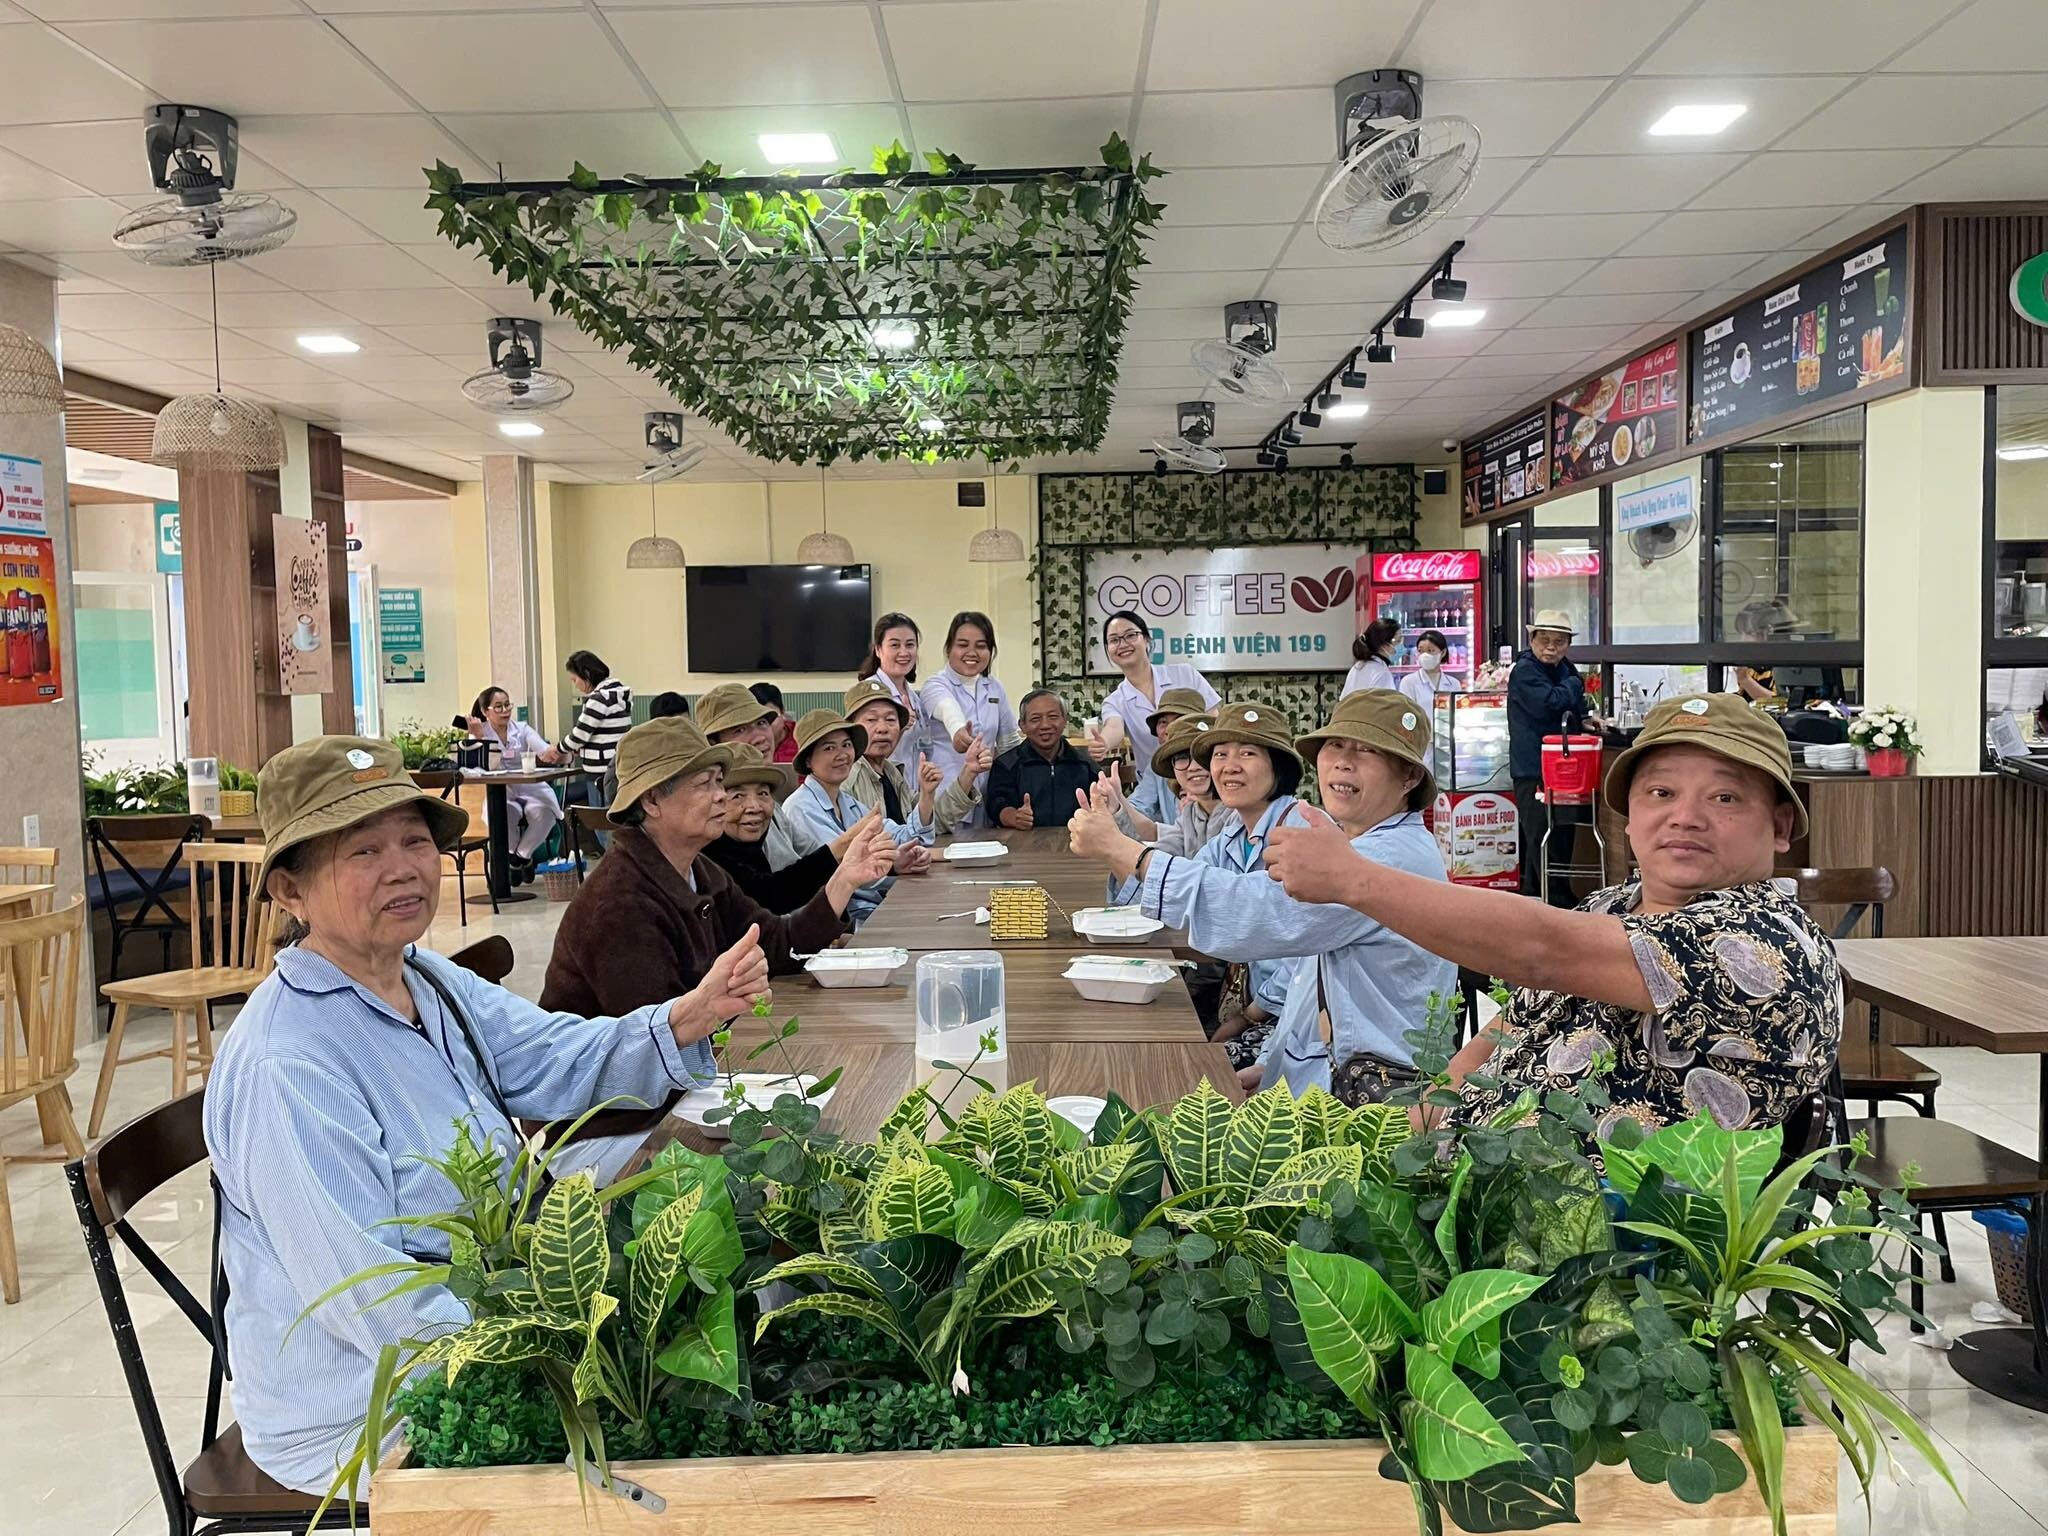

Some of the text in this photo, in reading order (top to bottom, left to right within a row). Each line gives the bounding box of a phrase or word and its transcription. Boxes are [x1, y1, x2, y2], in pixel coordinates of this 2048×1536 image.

[1098, 573, 1285, 617] COFFEE
[1170, 632, 1327, 658] BỆNH VIỆN 199
[1455, 813, 1472, 828] BÁNH
[1474, 813, 1485, 826] BAO
[1500, 810, 1516, 823] FOOD
